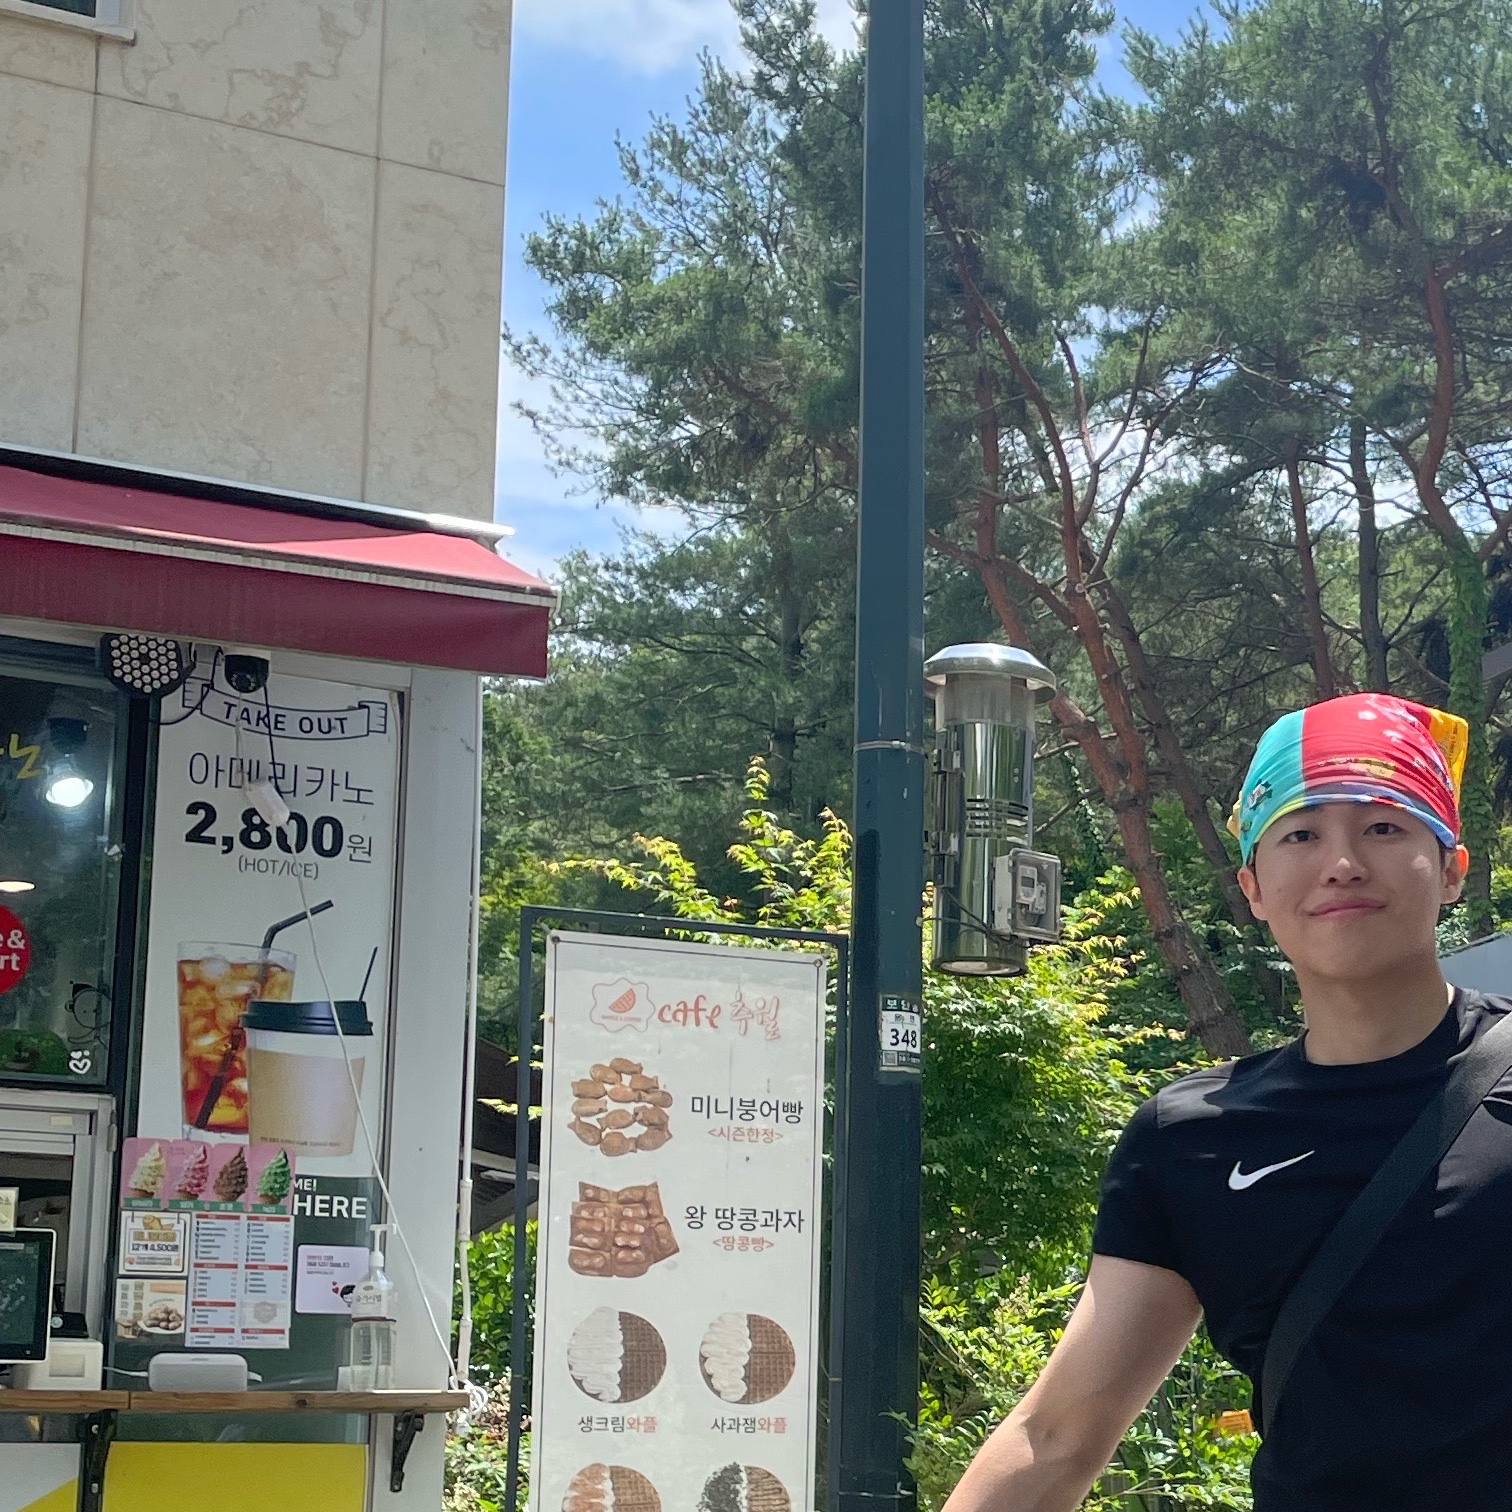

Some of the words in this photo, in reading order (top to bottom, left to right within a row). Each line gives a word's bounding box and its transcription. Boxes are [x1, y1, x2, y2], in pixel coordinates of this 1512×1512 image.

[223, 701, 287, 731] TAKE
[299, 716, 348, 734] OUT
[189, 752, 374, 805] 아메리카노
[238, 854, 319, 880] (HOT/ICE)
[657, 994, 723, 1029] cafe
[730, 991, 782, 1042] 추월
[889, 1028, 918, 1049] 348
[691, 1095, 804, 1124] 미니붕어빵
[292, 1194, 368, 1219] HERE
[685, 1205, 708, 1229] 왕
[714, 1206, 805, 1233] 땅콩과자
[578, 1416, 658, 1433] 생크림와플
[710, 1416, 788, 1434] 사과잼와플
